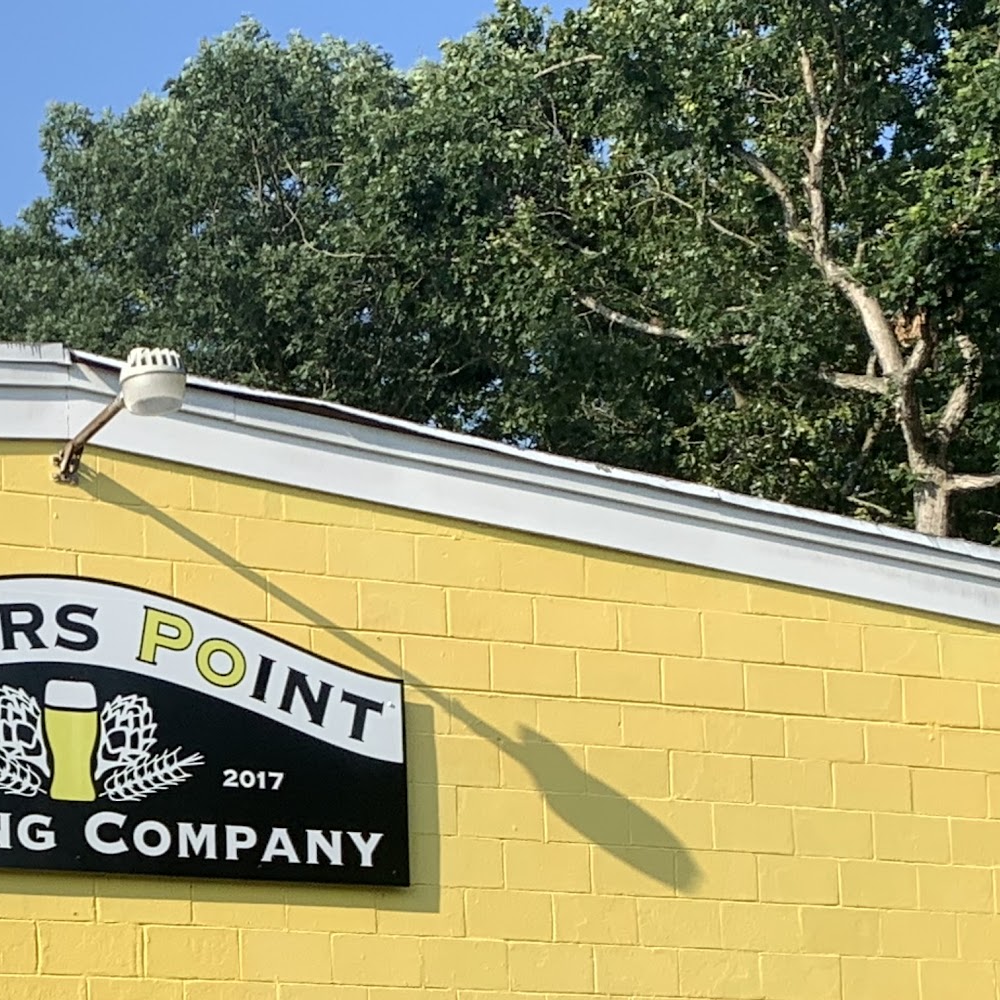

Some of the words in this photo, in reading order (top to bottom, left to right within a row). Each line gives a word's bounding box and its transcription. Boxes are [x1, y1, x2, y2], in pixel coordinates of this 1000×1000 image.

[136, 605, 384, 743] POINT
[222, 768, 284, 791] 2017
[85, 811, 384, 867] COMPANY
